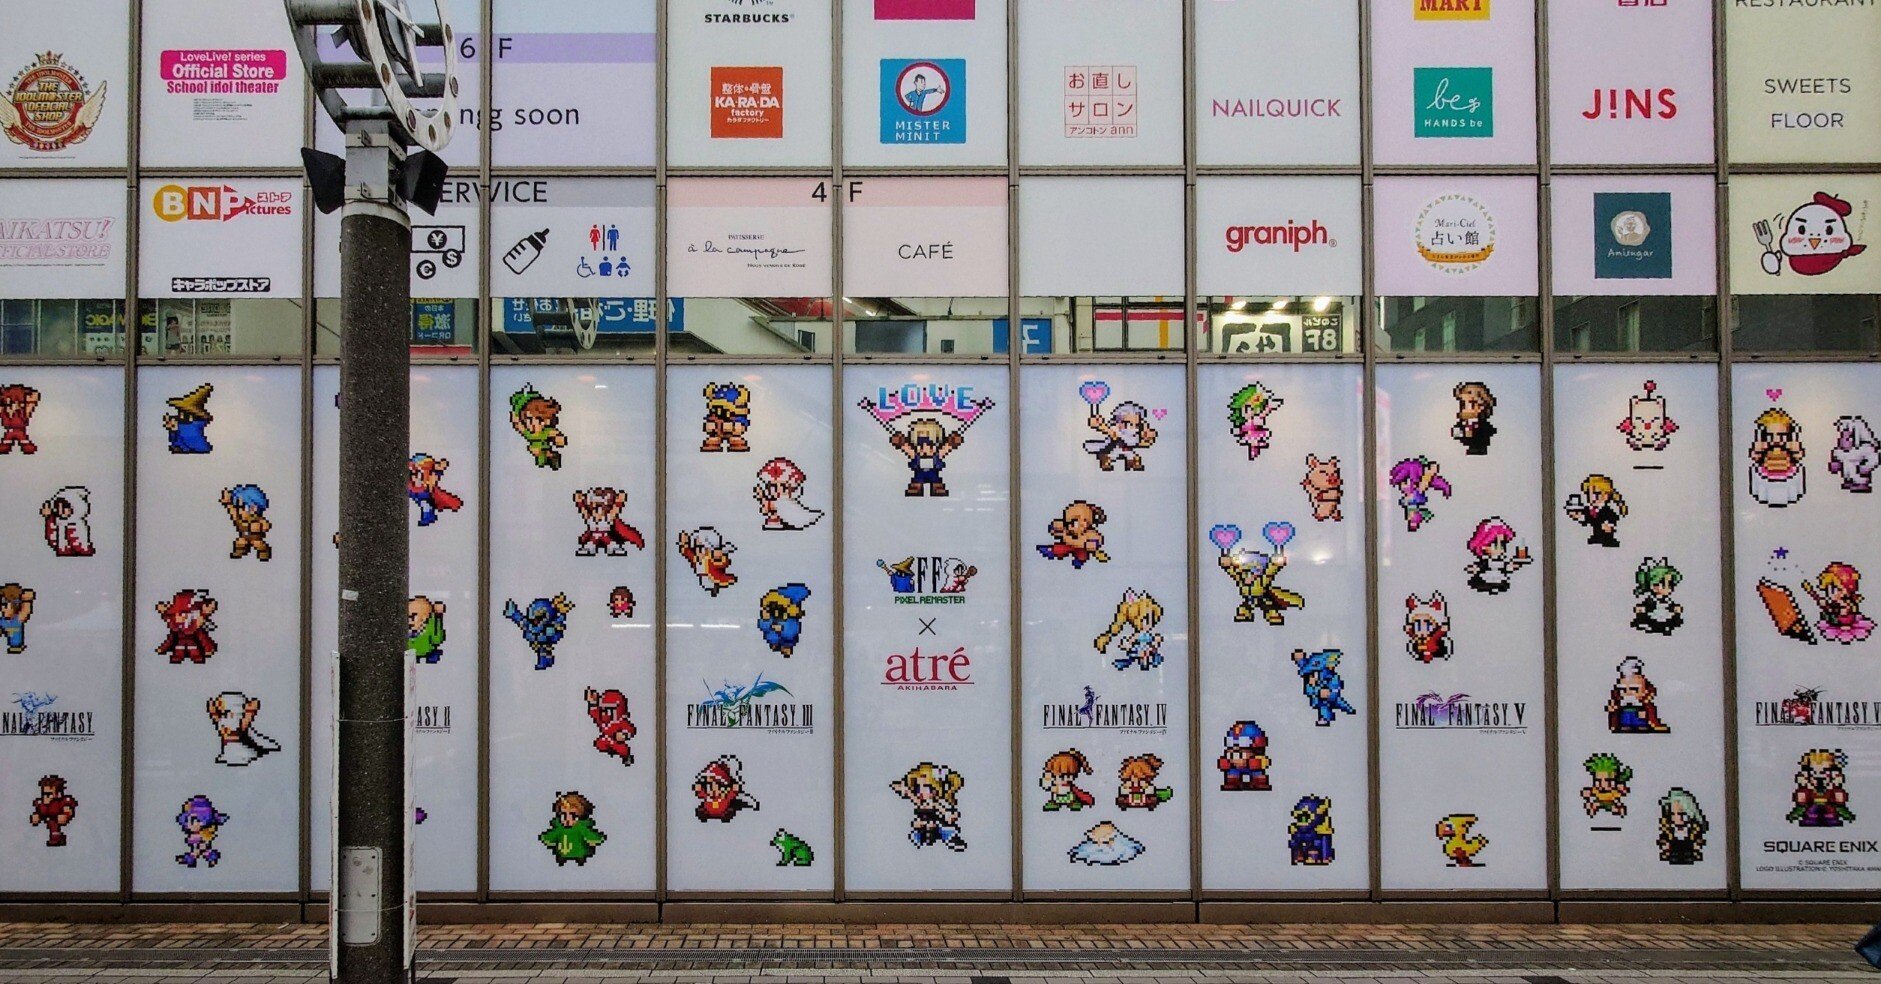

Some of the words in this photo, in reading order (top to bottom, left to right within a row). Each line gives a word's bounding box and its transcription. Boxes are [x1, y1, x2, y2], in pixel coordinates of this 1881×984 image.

[181, 52, 232, 61] LoveLive!
[234, 53, 266, 61] series
[172, 63, 228, 79] Official
[232, 63, 275, 79] Store
[167, 81, 208, 94] School
[210, 81, 233, 94] idol
[235, 81, 279, 94] theater
[1069, 73, 1131, 89] お直し
[1764, 78, 1851, 94] SWEETS
[731, 109, 764, 117] factory
[1068, 102, 1133, 117] サロン
[1213, 99, 1341, 117] NAILQUICK
[514, 108, 580, 125] soon
[1424, 119, 1466, 127] HANDS
[1469, 119, 1483, 127] be
[1771, 113, 1844, 128] FLOOR
[895, 121, 950, 130] MISTER
[1110, 126, 1134, 135] ann
[895, 132, 940, 141] MINIT
[257, 192, 292, 203] ストア
[440, 181, 548, 203] ERVICE
[1435, 218, 1476, 227] Mari-Ciel
[1226, 219, 1328, 252] graniph
[1431, 230, 1479, 246] 占い館
[898, 241, 954, 260] CAFÉ
[173, 279, 270, 291] キャラポップストア
[878, 384, 974, 410] LOVE
[895, 596, 918, 604] PIXEL
[920, 596, 965, 604] REMASTER
[885, 646, 971, 682] atré
[687, 704, 726, 726] FINAL
[739, 704, 796, 726] FANTASY
[1043, 704, 1082, 726] FINAL
[1096, 704, 1150, 726] FANTASY
[1156, 703, 1167, 726] IV
[1396, 703, 1434, 726] FINAL
[1448, 703, 1508, 726] FANTASY
[1514, 703, 1526, 726] V
[1810, 702, 1867, 723] FANTASY
[1764, 841, 1836, 853] SQUARE
[1840, 841, 1879, 852] ENIX
